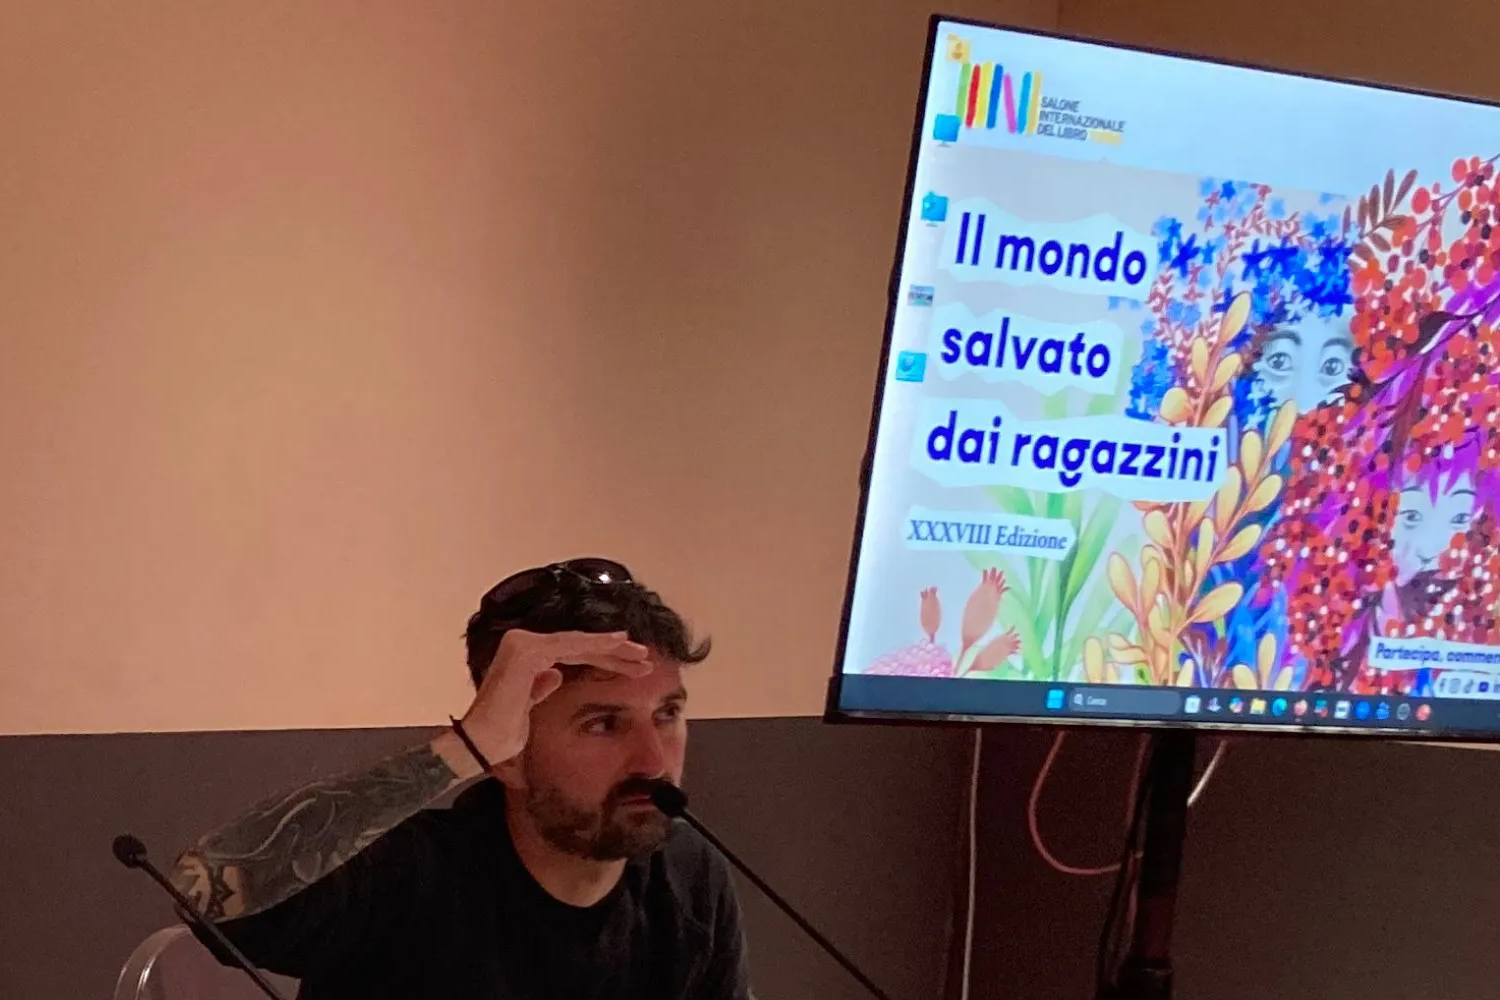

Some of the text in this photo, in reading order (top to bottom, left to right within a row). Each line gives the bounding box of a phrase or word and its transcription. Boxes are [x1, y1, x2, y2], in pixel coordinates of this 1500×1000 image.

[1041, 96, 1080, 112] SALONE
[1037, 123, 1088, 141] DEL LIBRO
[1039, 110, 1126, 132] INTERNAZIONALE
[955, 211, 1148, 286] Il mondo
[941, 317, 1111, 378] salvato
[926, 410, 1221, 488] dai ragazzini
[907, 518, 1068, 550] XXXVIII Edizione
